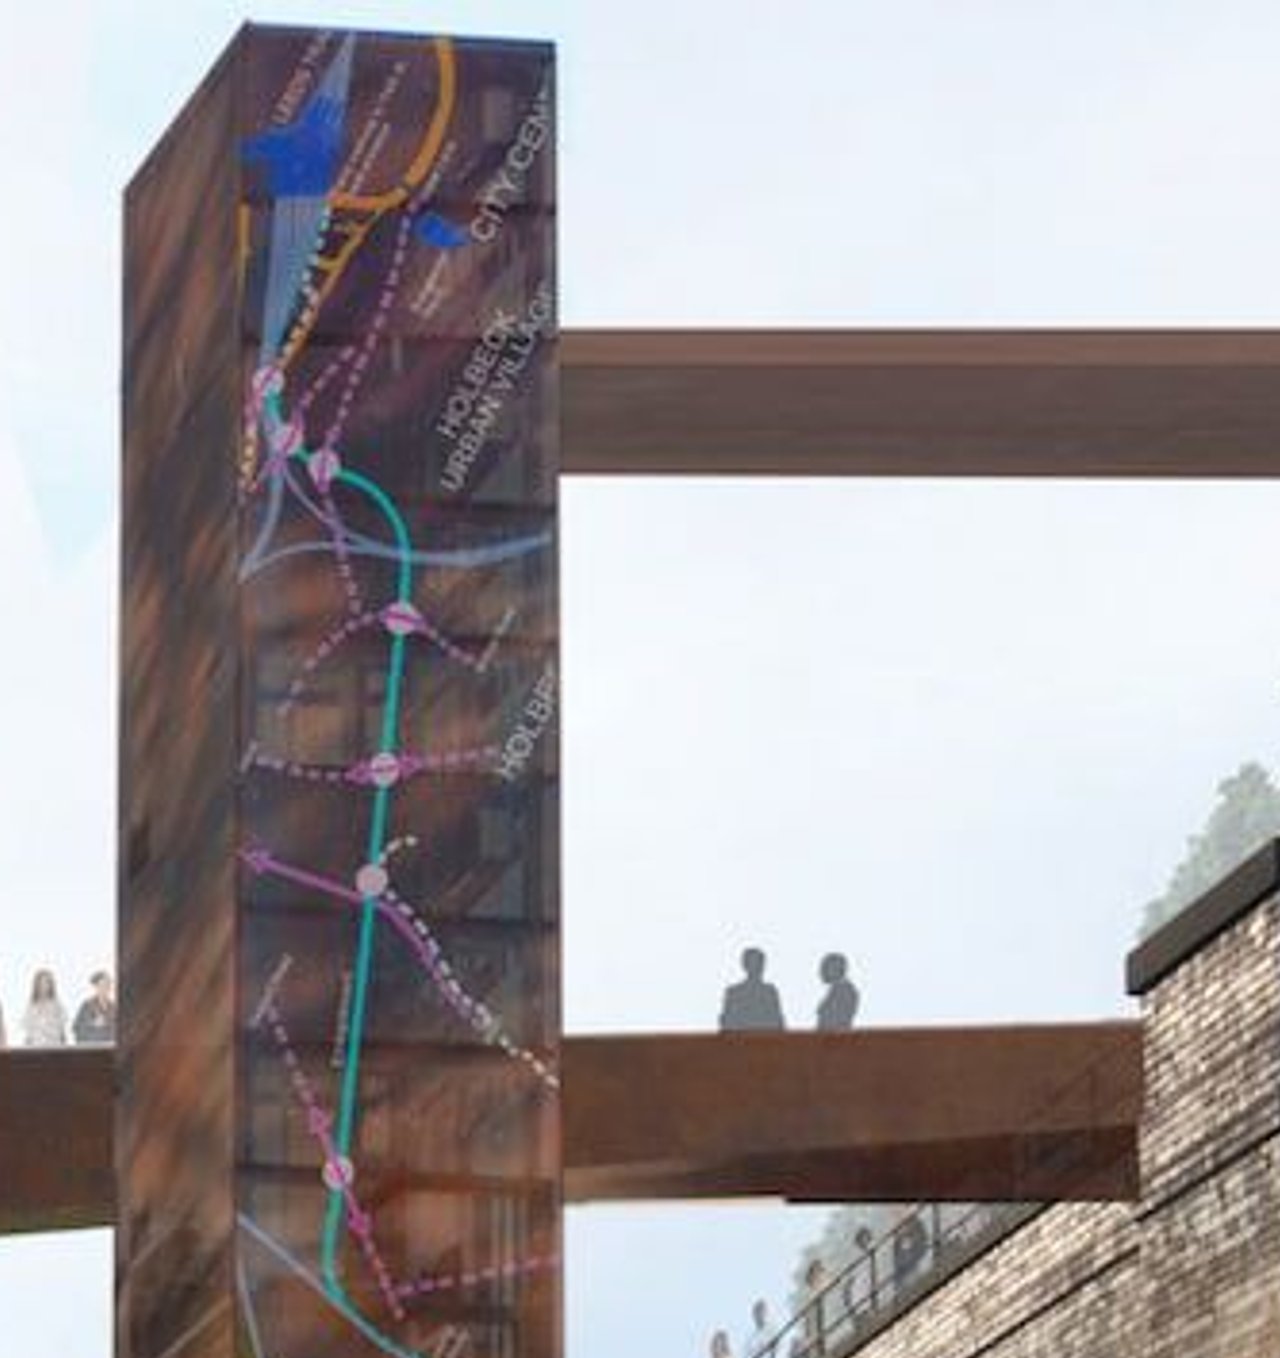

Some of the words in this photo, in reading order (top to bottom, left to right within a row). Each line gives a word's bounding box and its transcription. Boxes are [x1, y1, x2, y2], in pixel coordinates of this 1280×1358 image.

[471, 167, 516, 242] CITY
[436, 306, 517, 440] HOLBECK
[440, 396, 502, 492] URBAN
